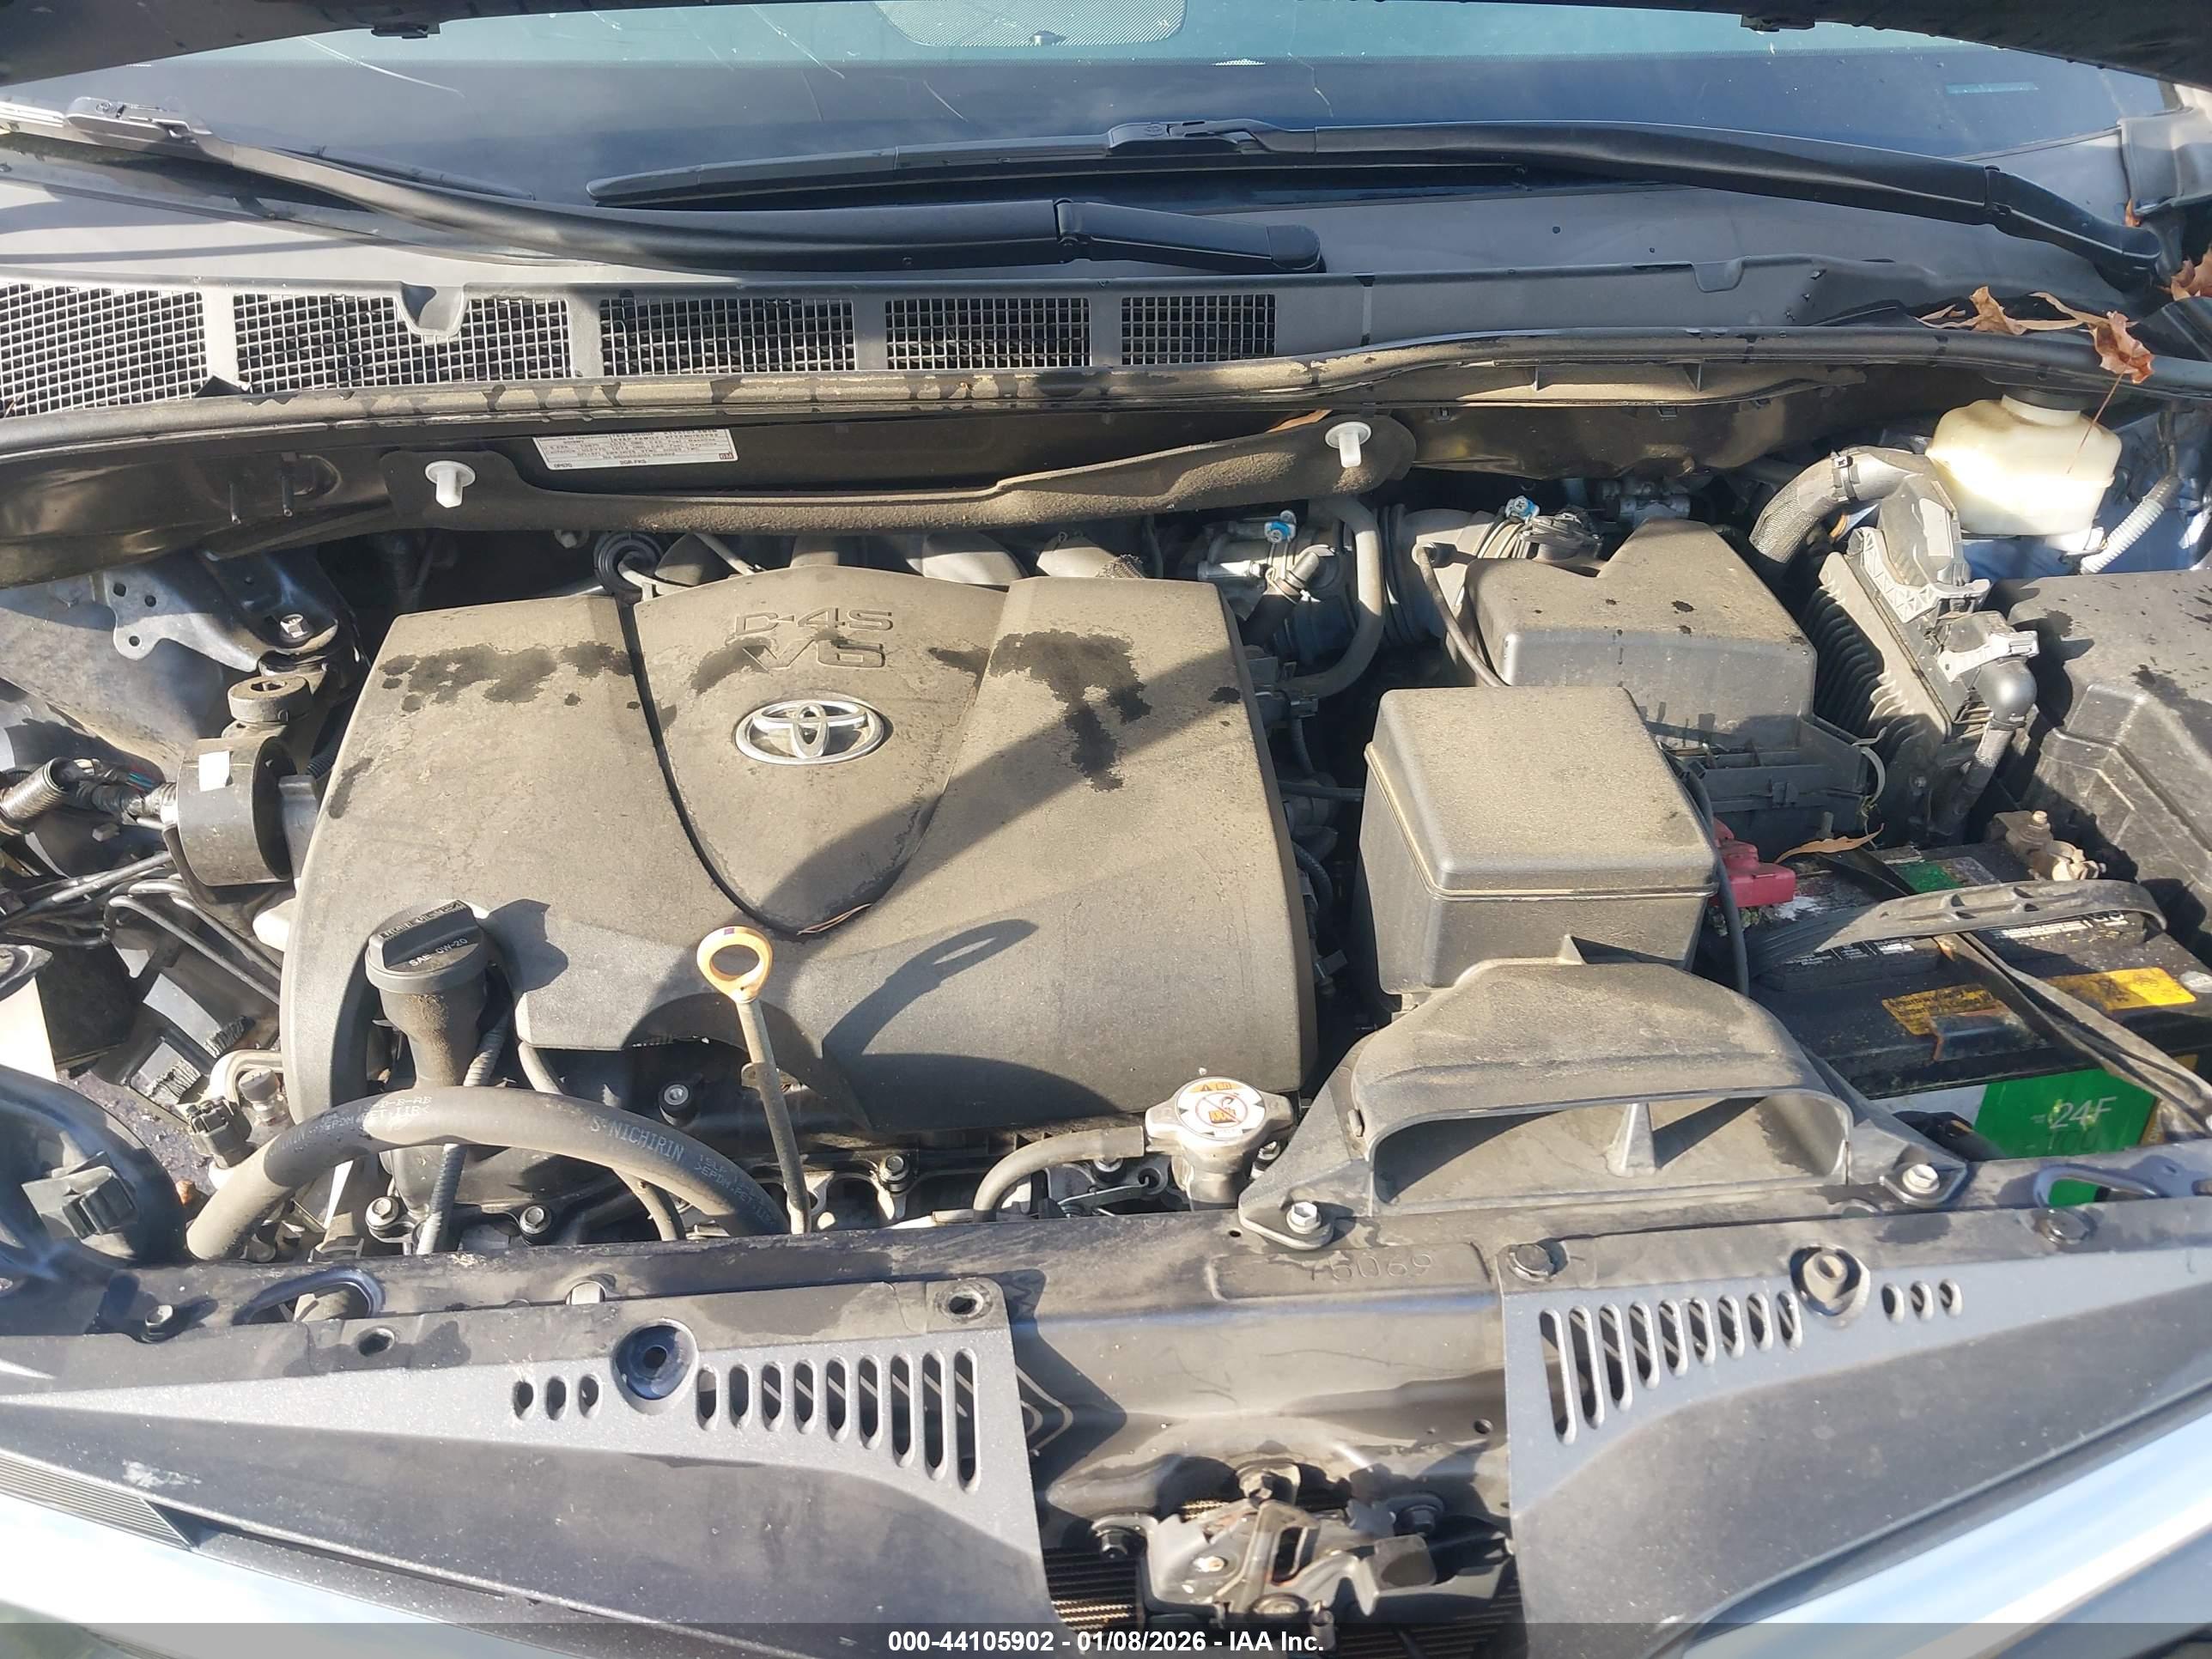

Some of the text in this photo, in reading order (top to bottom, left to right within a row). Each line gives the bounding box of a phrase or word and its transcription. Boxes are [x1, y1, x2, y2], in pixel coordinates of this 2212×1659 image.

[734, 606, 894, 637] D-4S
[740, 639, 886, 671] V6
[408, 938, 468, 967] SAE 0W-20
[2049, 1096, 2118, 1130] 24F
[609, 1119, 685, 1162] NICHIRIN
